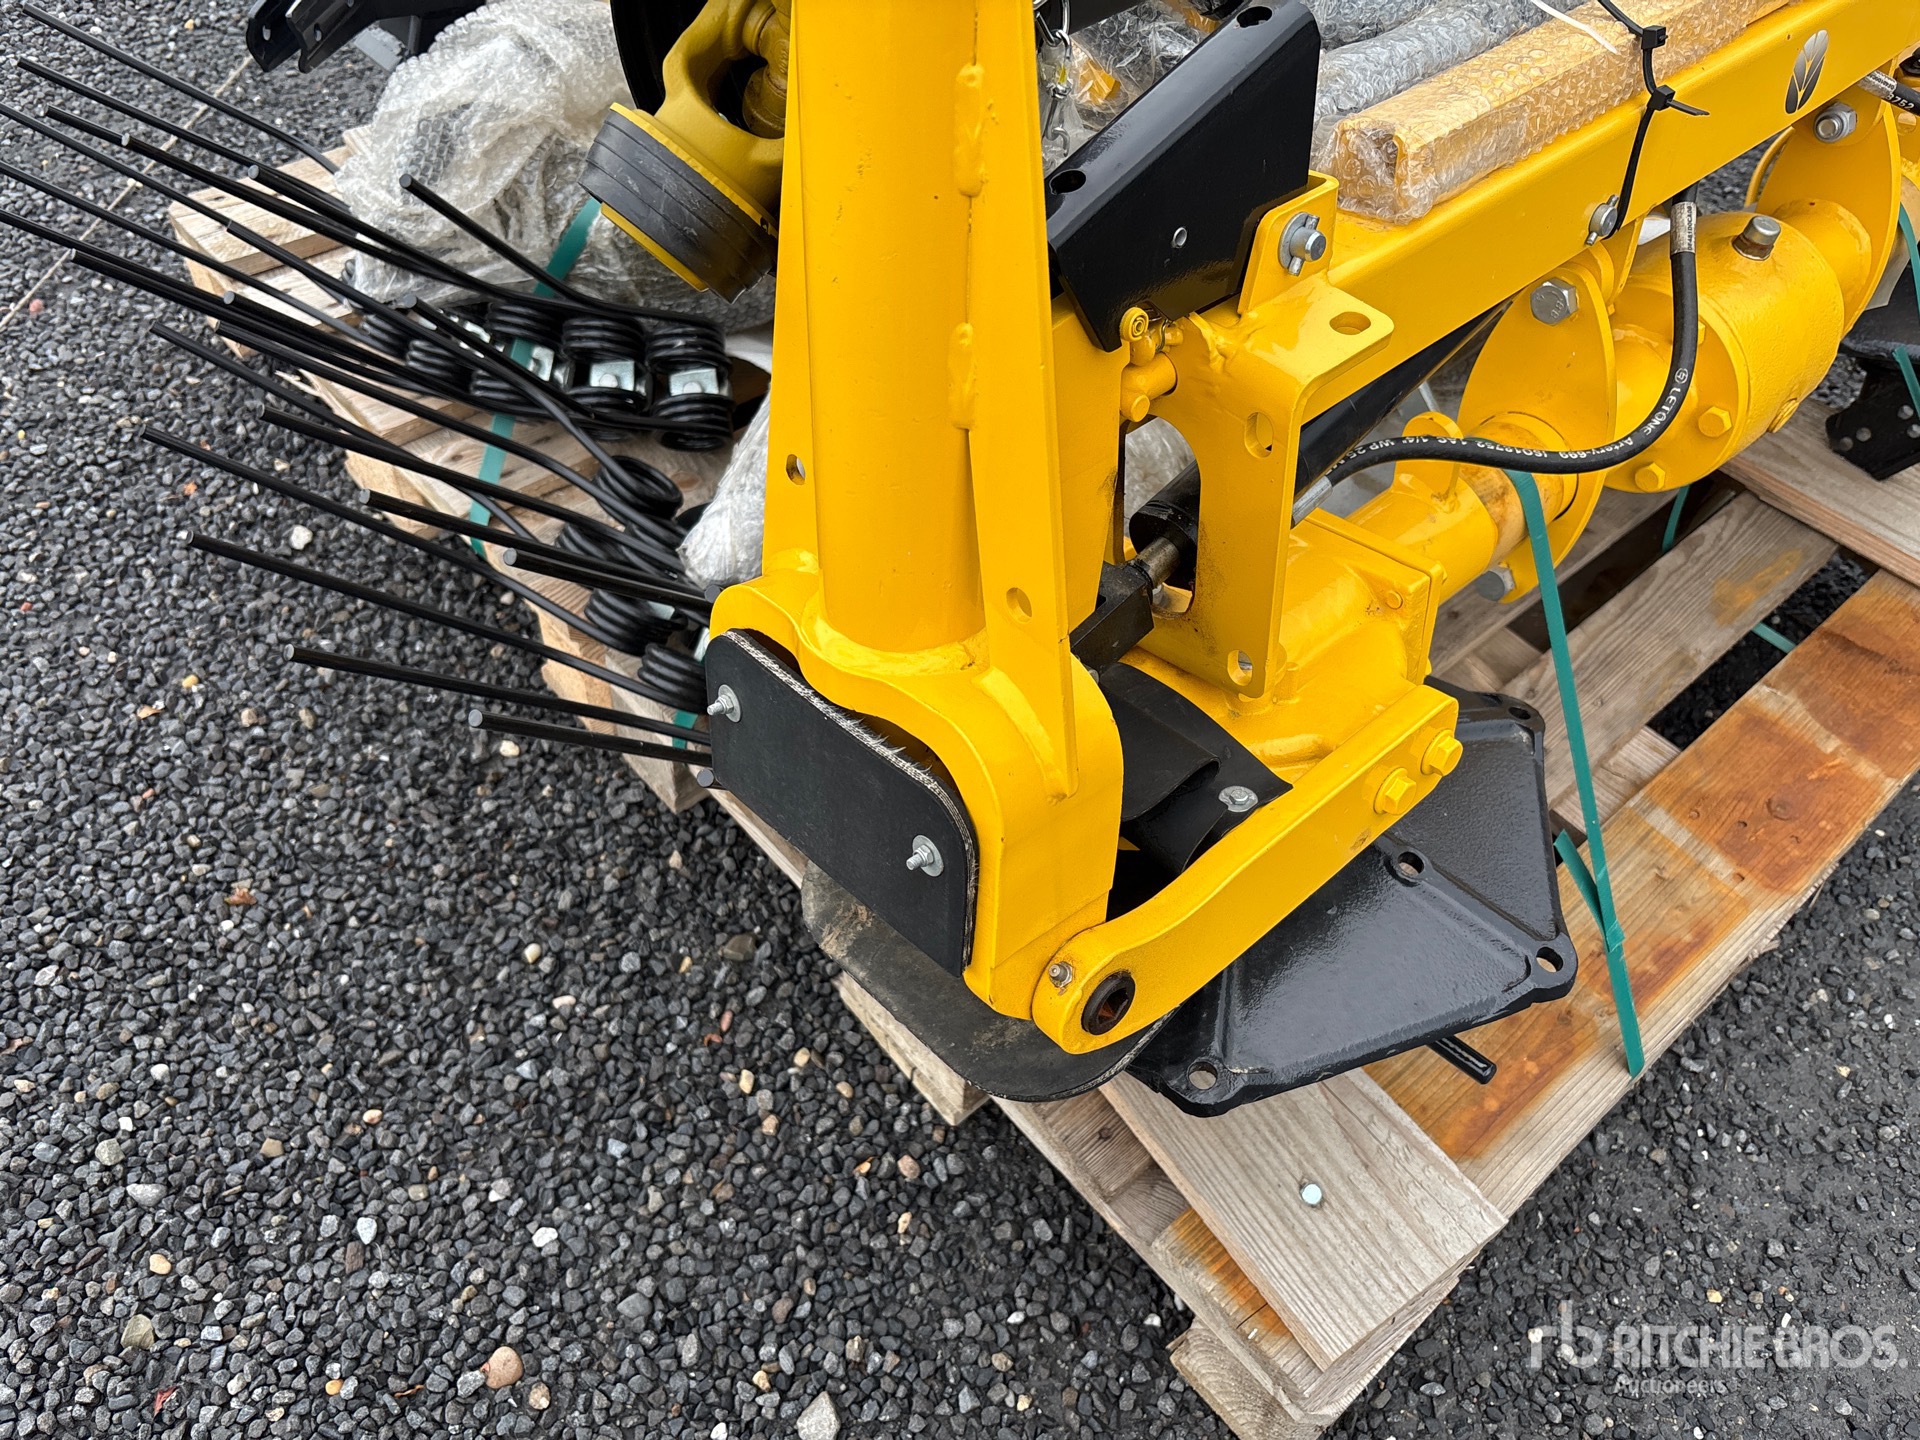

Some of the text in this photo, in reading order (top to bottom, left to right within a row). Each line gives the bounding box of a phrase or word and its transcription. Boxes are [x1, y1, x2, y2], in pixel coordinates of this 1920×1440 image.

[1643, 387, 1681, 435] LETONE
[1369, 439, 1395, 451] WP
[1559, 436, 1634, 459] Artery-699
